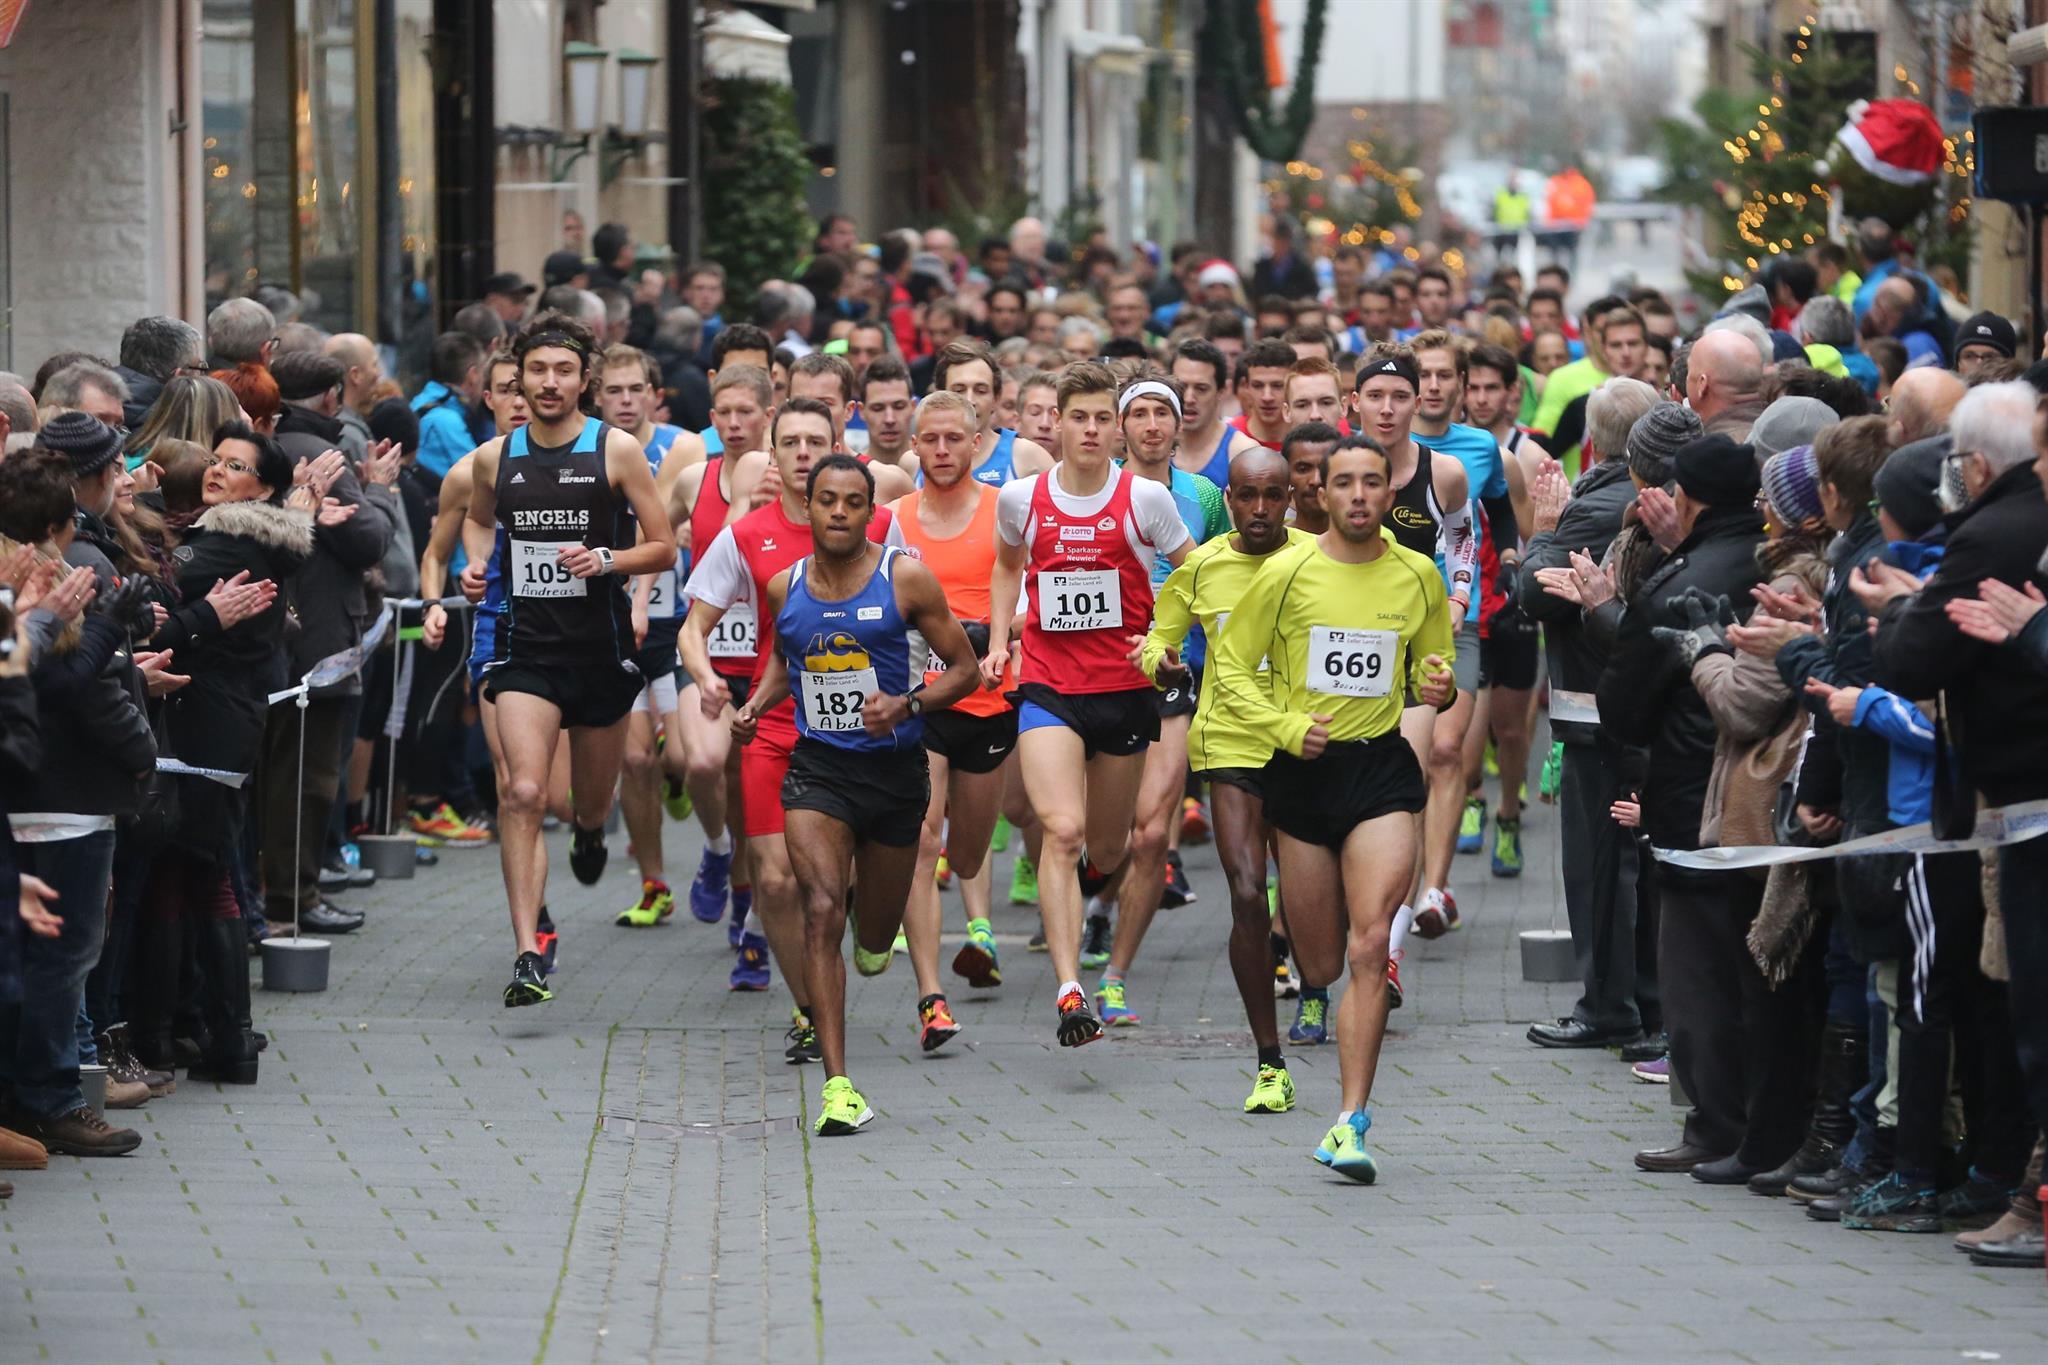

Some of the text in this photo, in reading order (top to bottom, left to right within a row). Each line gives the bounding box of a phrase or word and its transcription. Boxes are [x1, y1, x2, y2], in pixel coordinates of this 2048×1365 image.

[513, 510, 589, 526] ENGELS
[1398, 510, 1409, 518] LG
[1067, 546, 1102, 554] Sparkasse
[524, 562, 572, 584] 105
[521, 583, 575, 597] Andreas
[1057, 592, 1110, 616] 101
[1049, 617, 1103, 629] Moritz
[1324, 651, 1381, 679] 669
[815, 690, 865, 716] 182
[820, 717, 861, 730] Abd
